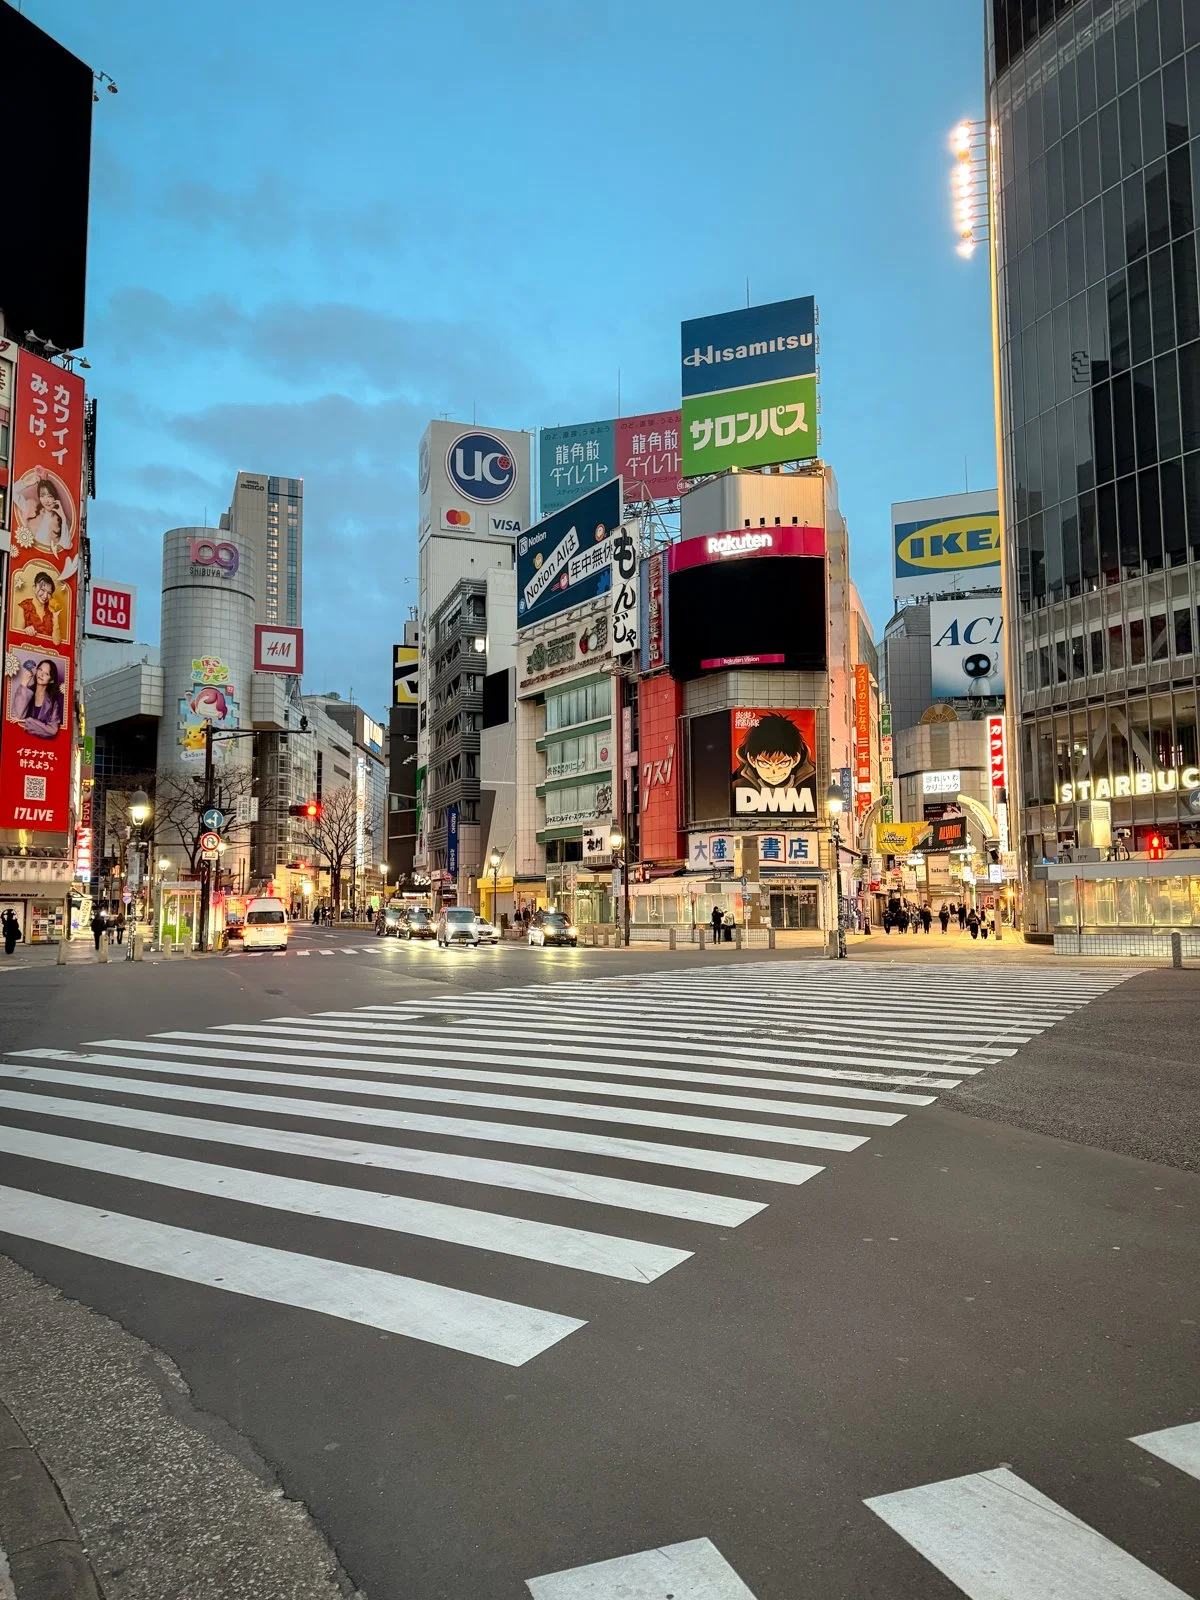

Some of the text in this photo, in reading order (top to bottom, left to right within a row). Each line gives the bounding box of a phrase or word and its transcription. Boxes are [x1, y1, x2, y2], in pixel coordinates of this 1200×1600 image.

[683, 332, 813, 367] Hisamitsu
[29, 372, 49, 449] みつけ。
[52, 384, 70, 466] カワイイ
[690, 402, 808, 451] サロンパス
[555, 440, 600, 466] 龍角散
[632, 429, 678, 455] 龍角散
[455, 448, 511, 485] UC
[625, 452, 683, 477] ダイレクト
[240, 483, 265, 491] INDIGO
[491, 518, 521, 531] VISA
[528, 531, 547, 548] Notion
[707, 533, 773, 554] Rakuten
[186, 537, 240, 579] 109
[570, 544, 613, 580] 年中無休
[189, 567, 221, 577] SHIBUYA
[526, 564, 556, 600] Notion
[613, 527, 637, 647] もんじゃ
[96, 592, 124, 610] UNI
[96, 607, 126, 625] QLO
[933, 616, 1003, 647] AC
[266, 641, 292, 658] H&M
[723, 655, 760, 665] Rakuten Vision
[858, 668, 870, 777] クスリのことなら 三千里
[16, 748, 58, 761] イチナナで、
[20, 758, 54, 771] 叶えよう。
[990, 724, 1004, 780] カラオケ
[642, 743, 675, 812] クスリ
[925, 783, 959, 792] クリニック
[933, 775, 959, 783] れいわ
[735, 787, 815, 813] DMM
[14, 806, 54, 822] 17LIVE
[694, 838, 809, 862] 大盛書店
